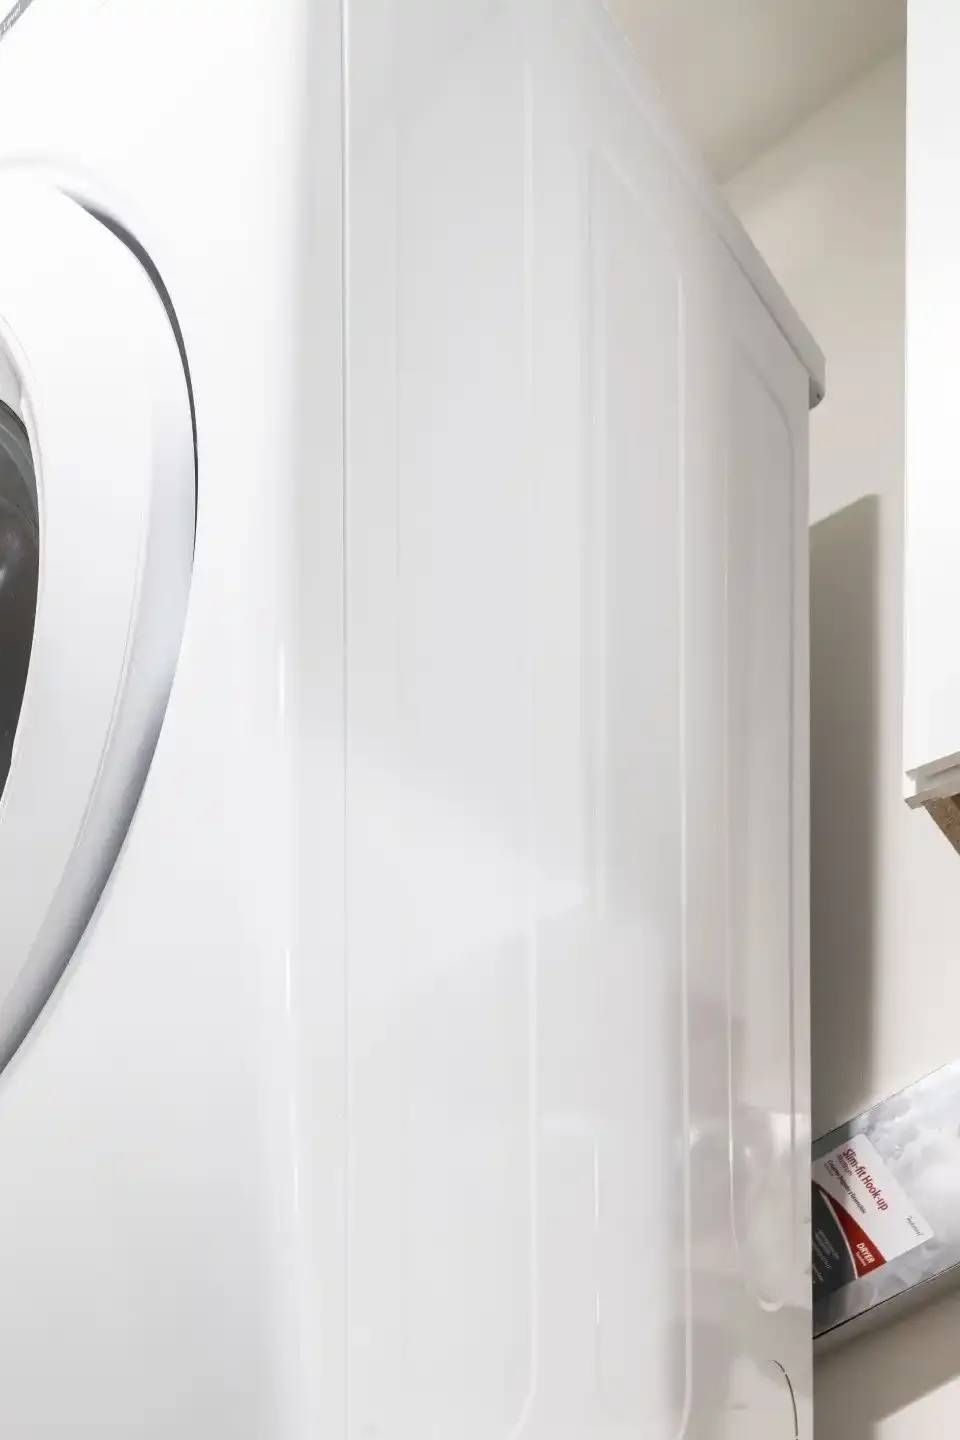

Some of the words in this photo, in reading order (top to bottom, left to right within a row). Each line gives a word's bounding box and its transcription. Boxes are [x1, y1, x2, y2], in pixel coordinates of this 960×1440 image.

[843, 1148, 867, 1179] Slim-fit
[862, 1174, 889, 1211] Hook-up
[856, 1242, 875, 1265] DRYER
